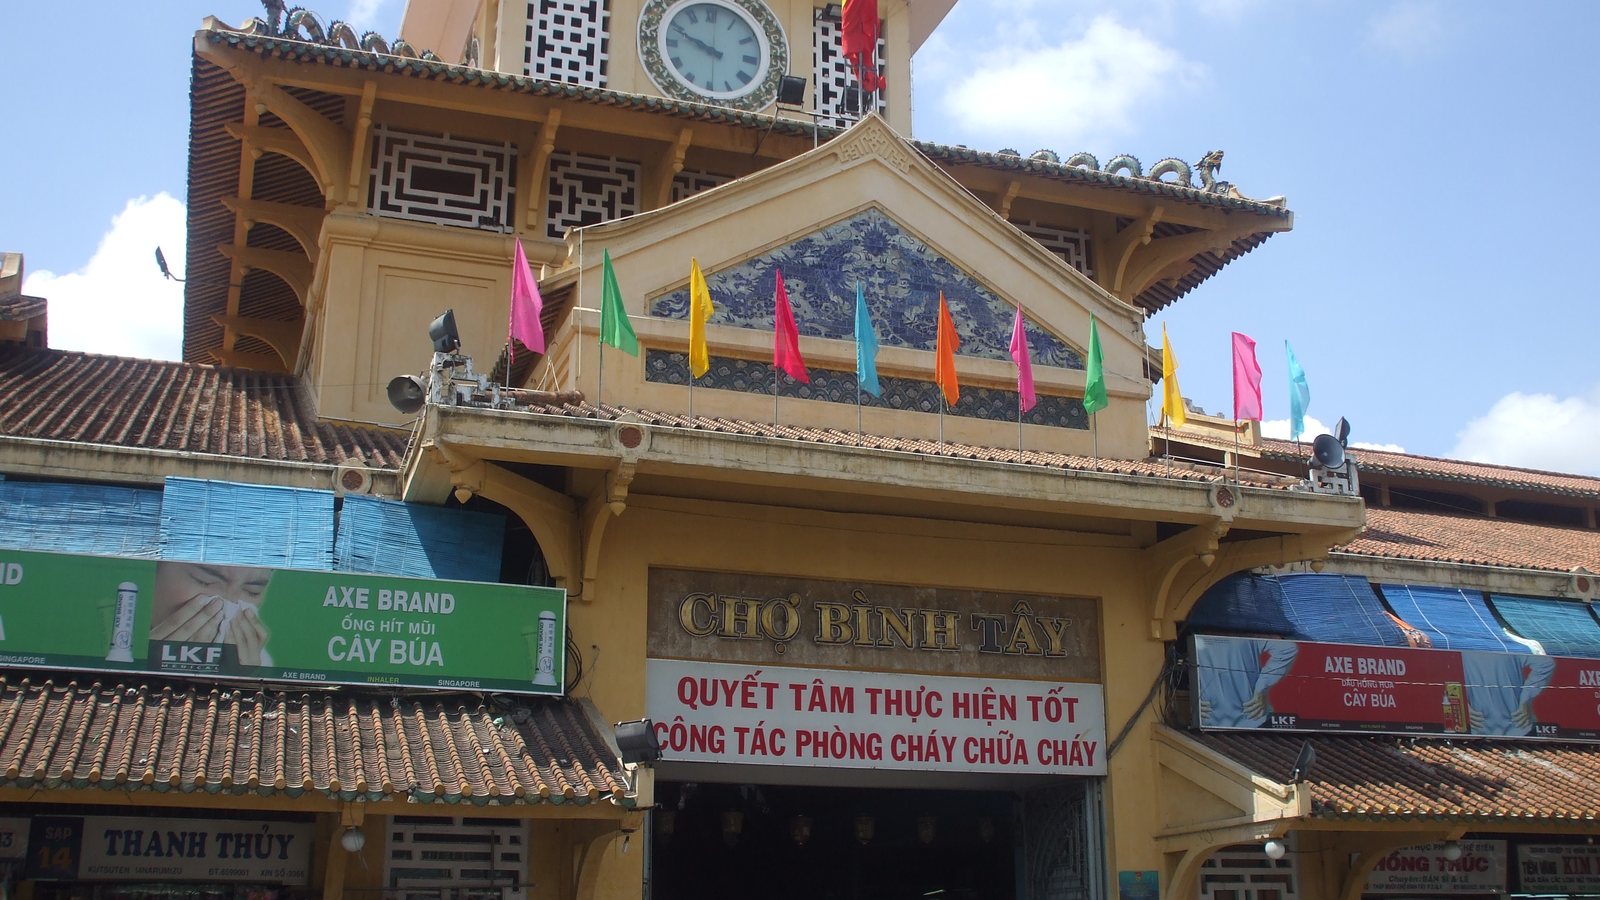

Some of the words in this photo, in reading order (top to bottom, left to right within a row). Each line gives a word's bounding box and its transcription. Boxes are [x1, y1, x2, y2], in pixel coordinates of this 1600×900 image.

[0, 563, 24, 585] D
[322, 586, 369, 609] AXE
[378, 589, 455, 614] BRAND
[342, 613, 375, 632] ỐNG
[380, 618, 404, 633] HÍT
[409, 619, 435, 635] MŨI
[678, 592, 801, 655] CHỢ
[814, 589, 961, 651] BÌNH
[970, 600, 1072, 658] TÂY
[161, 645, 222, 663] LKF
[328, 634, 381, 663] CÂY
[390, 637, 444, 666] BÚA
[282, 671, 298, 679] AXE
[300, 673, 326, 681] BRAND
[1325, 656, 1354, 674] AXE
[1357, 657, 1406, 676] BRAND
[367, 676, 400, 684] INHALER
[438, 679, 480, 688] SINGAPORE
[677, 670, 779, 711] QUYẾT
[789, 678, 854, 714] TÂM
[865, 685, 943, 723] THỰC
[952, 686, 1017, 726] HIỆN
[1026, 686, 1079, 723] TỐT
[1344, 688, 1367, 707] CÂY
[1371, 690, 1396, 708] BÚA
[1271, 716, 1296, 724] LKF
[1535, 725, 1557, 734] LKF
[654, 715, 725, 754] CÔNG
[733, 720, 786, 756] TÁC
[795, 725, 882, 761] PHÒNG
[890, 729, 957, 763] CHÁY
[963, 729, 1029, 765] CHỮA
[1037, 733, 1097, 767] CHÁY
[104, 830, 208, 858] THANH
[216, 824, 295, 860] THỦY
[38, 847, 73, 870] 14
